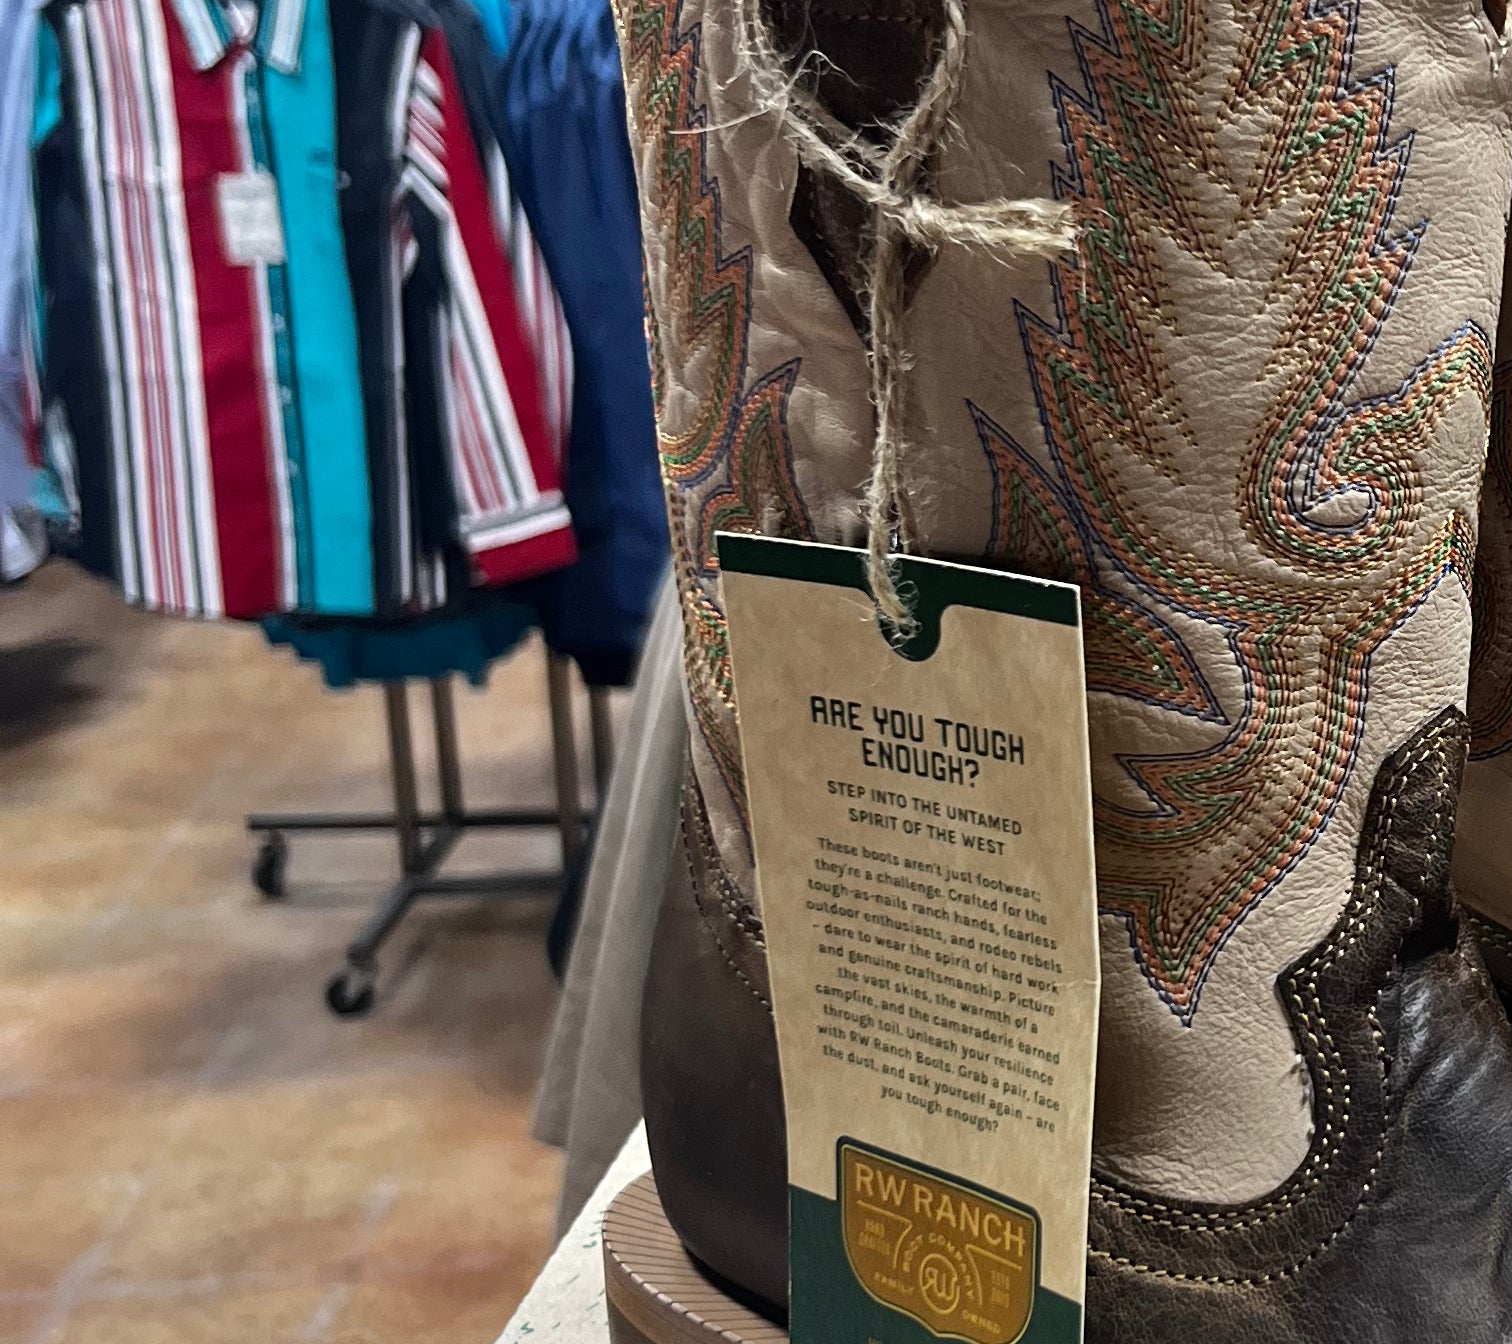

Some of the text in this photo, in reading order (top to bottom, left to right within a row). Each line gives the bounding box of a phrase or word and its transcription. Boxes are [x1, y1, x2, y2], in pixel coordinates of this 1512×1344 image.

[810, 695, 1025, 765] ARE YOU TOUGH
[862, 738, 980, 788] ENOUGH?
[827, 780, 1022, 835] STEP INTO THE UNTAMED
[849, 808, 1005, 855] SPIRIT OF THE WEST
[814, 858, 1047, 925] they're a challenge. Crafted for the
[817, 837, 858, 856] These
[862, 846, 900, 866] boots
[904, 858, 942, 876] aren't
[945, 865, 973, 884] just
[806, 900, 1063, 974] outdoor enthusiasts, and rodeo rebels
[807, 878, 1057, 950] tough-as-nails ranch hands, fearless
[818, 943, 1055, 1017] and genuine craftsmanship. Picture
[824, 922, 854, 939] dare
[857, 930, 872, 943] to
[875, 936, 906, 952] wear
[910, 943, 931, 959] the
[935, 951, 970, 970] spirit
[975, 961, 988, 974] of
[992, 963, 1023, 985] hard
[1027, 976, 1059, 995] work
[815, 983, 1060, 1065] campfire, and the camaraderie earned
[837, 966, 1038, 1034] the vast skies, the warmth of a
[817, 1024, 1060, 1112] with RW Ranch Boots. Grab a pair, face
[823, 1003, 1054, 1086] through toil. Unleash your resilience
[822, 1044, 844, 1060] the
[847, 1051, 879, 1072] dust,
[881, 1063, 905, 1080] and
[908, 1072, 931, 1089] ask
[934, 1080, 986, 1105] yourself
[989, 1099, 1023, 1120] again
[1036, 1117, 1056, 1133] are
[881, 1084, 999, 1133] you tough enough?
[855, 1162, 907, 1206] RW
[913, 1183, 1026, 1257] RANCH
